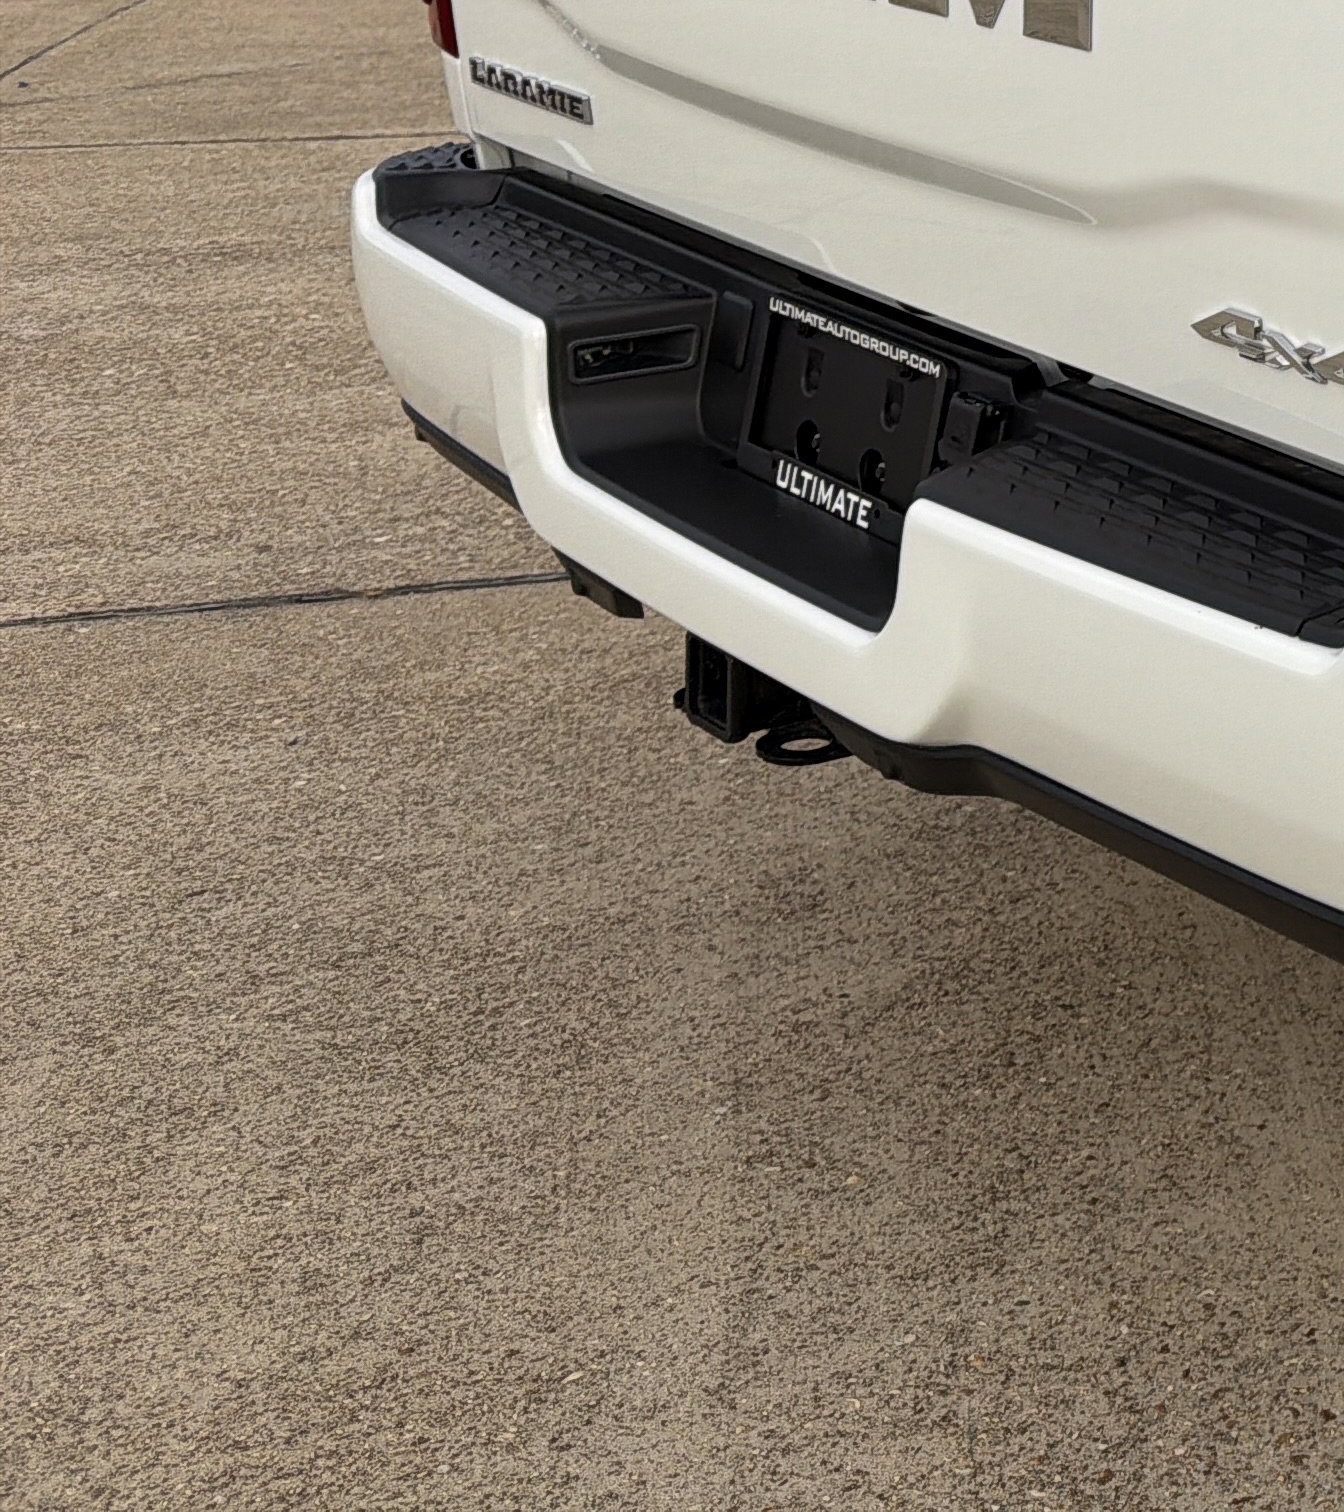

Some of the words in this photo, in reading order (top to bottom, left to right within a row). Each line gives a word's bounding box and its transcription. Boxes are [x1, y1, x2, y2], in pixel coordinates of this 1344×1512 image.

[468, 55, 595, 126] LARAMIE
[768, 295, 941, 379] ULTIMATEAUTOGROUP.COM
[774, 458, 873, 530] ULTIMATE
